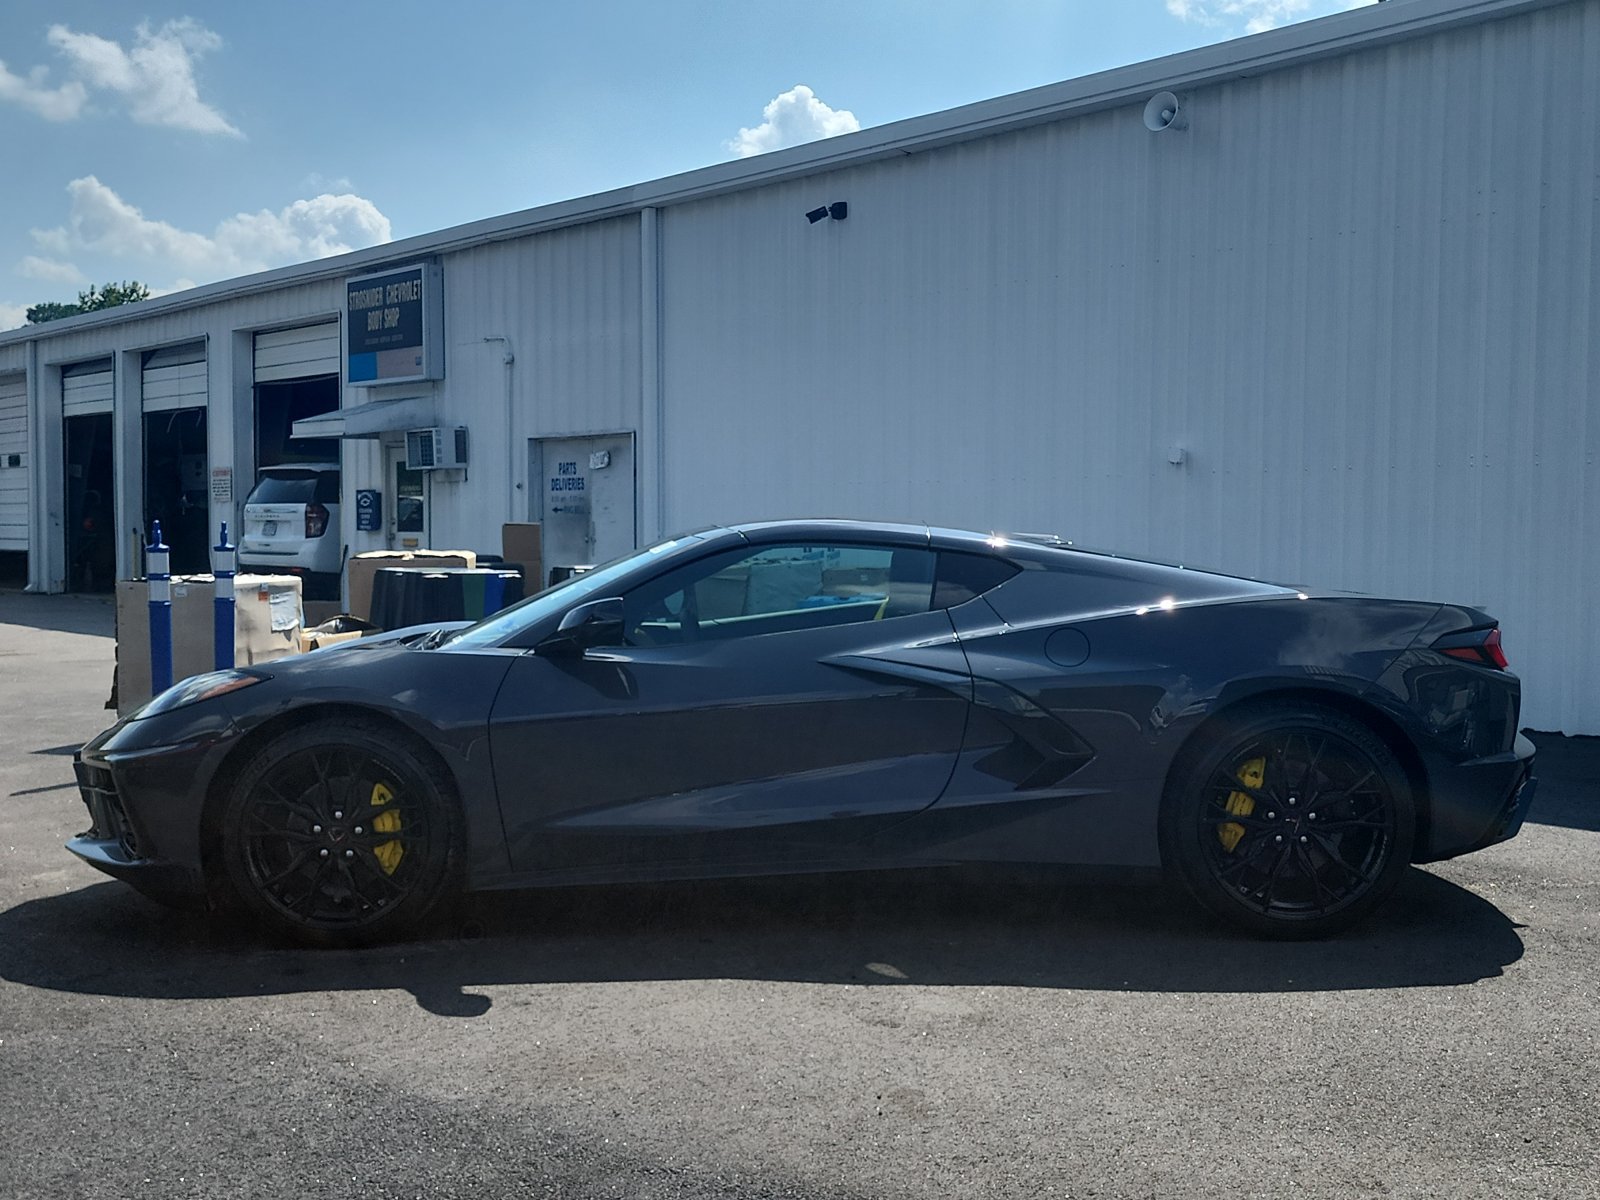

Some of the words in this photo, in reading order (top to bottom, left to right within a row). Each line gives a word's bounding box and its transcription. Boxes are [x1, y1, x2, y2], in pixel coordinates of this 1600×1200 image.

[386, 279, 421, 305] CHEVROLET
[367, 310, 383, 331] BODY
[384, 307, 400, 328] SHOP
[558, 462, 577, 475] PARTS
[551, 477, 585, 491] DELIVERIES
